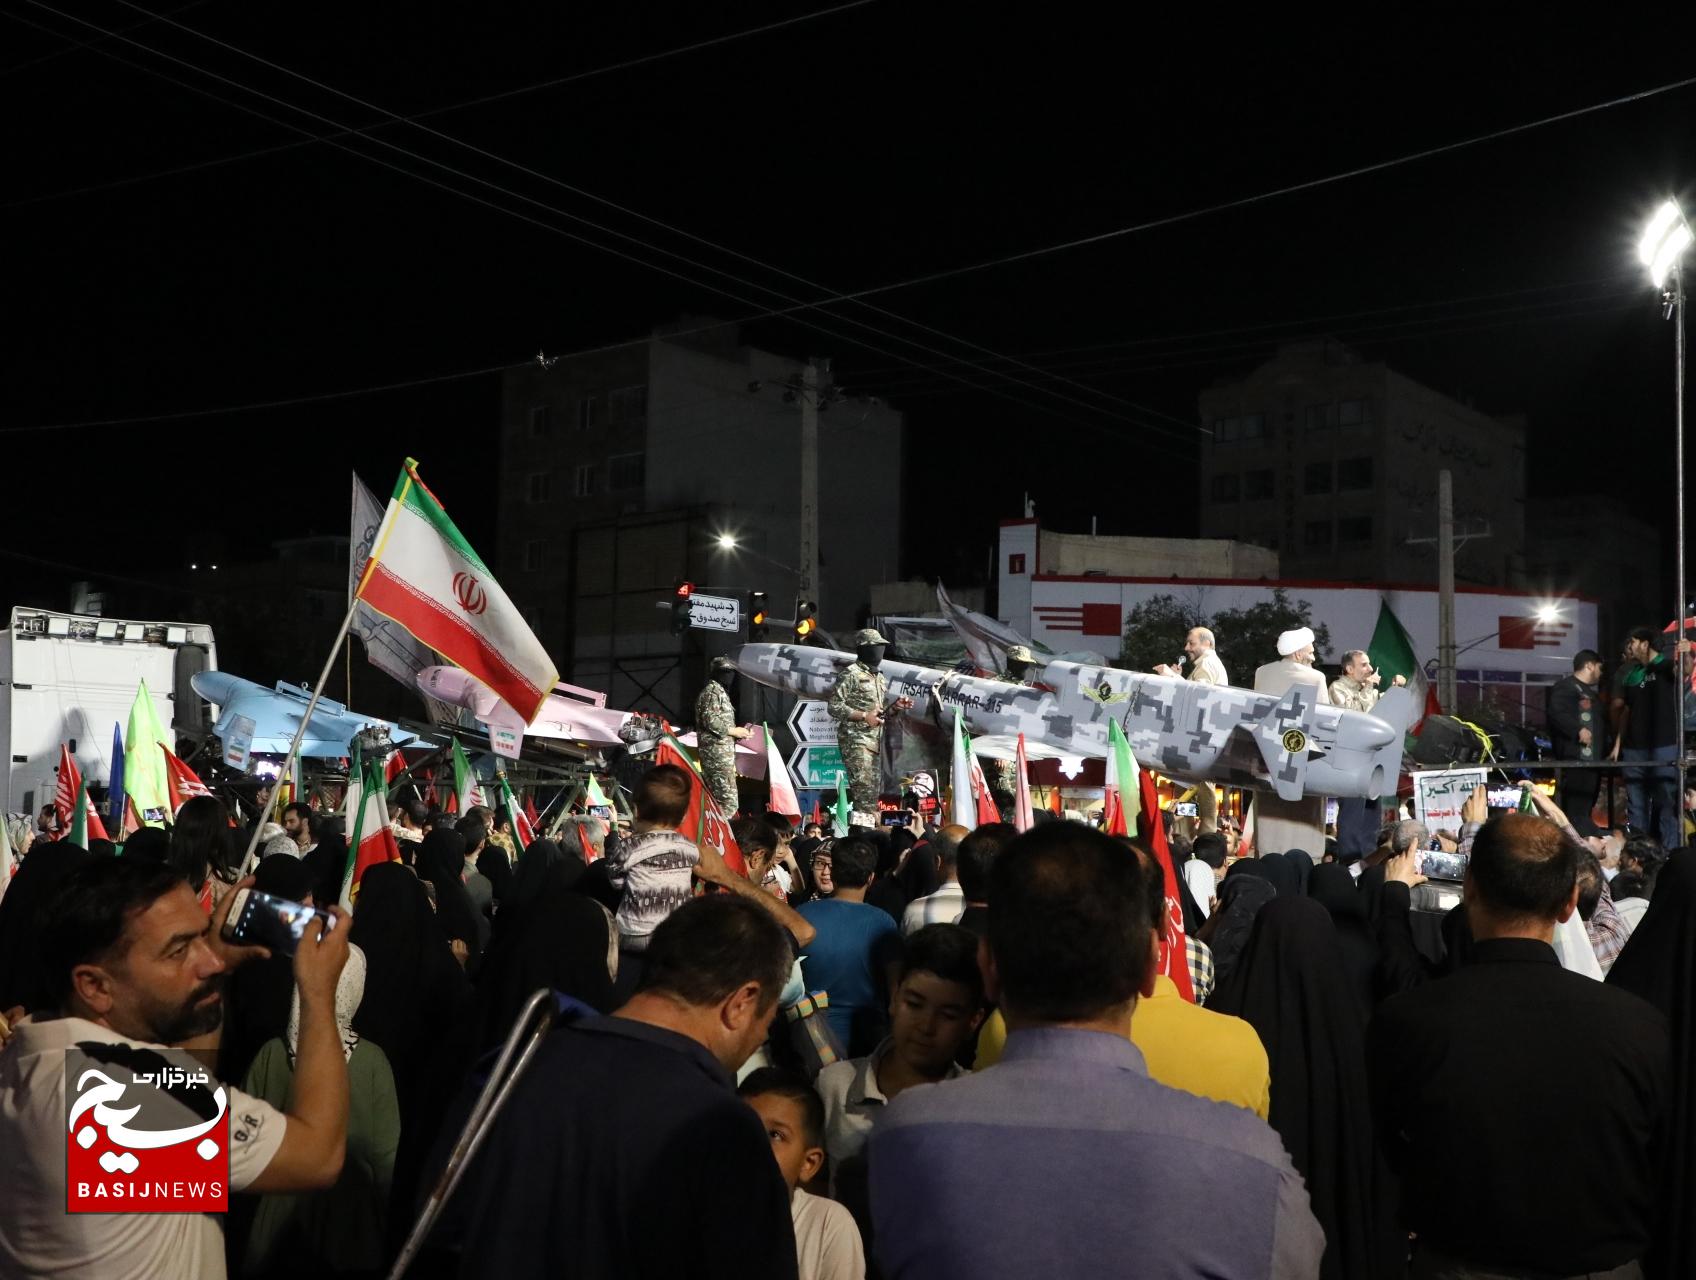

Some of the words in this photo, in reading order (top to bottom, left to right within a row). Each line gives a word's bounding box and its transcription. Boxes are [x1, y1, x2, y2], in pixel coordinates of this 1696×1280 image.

[691, 598, 705, 607] مفت
[705, 601, 724, 612] شهید
[696, 613, 720, 624] صدوق
[720, 615, 736, 628] شیخ
